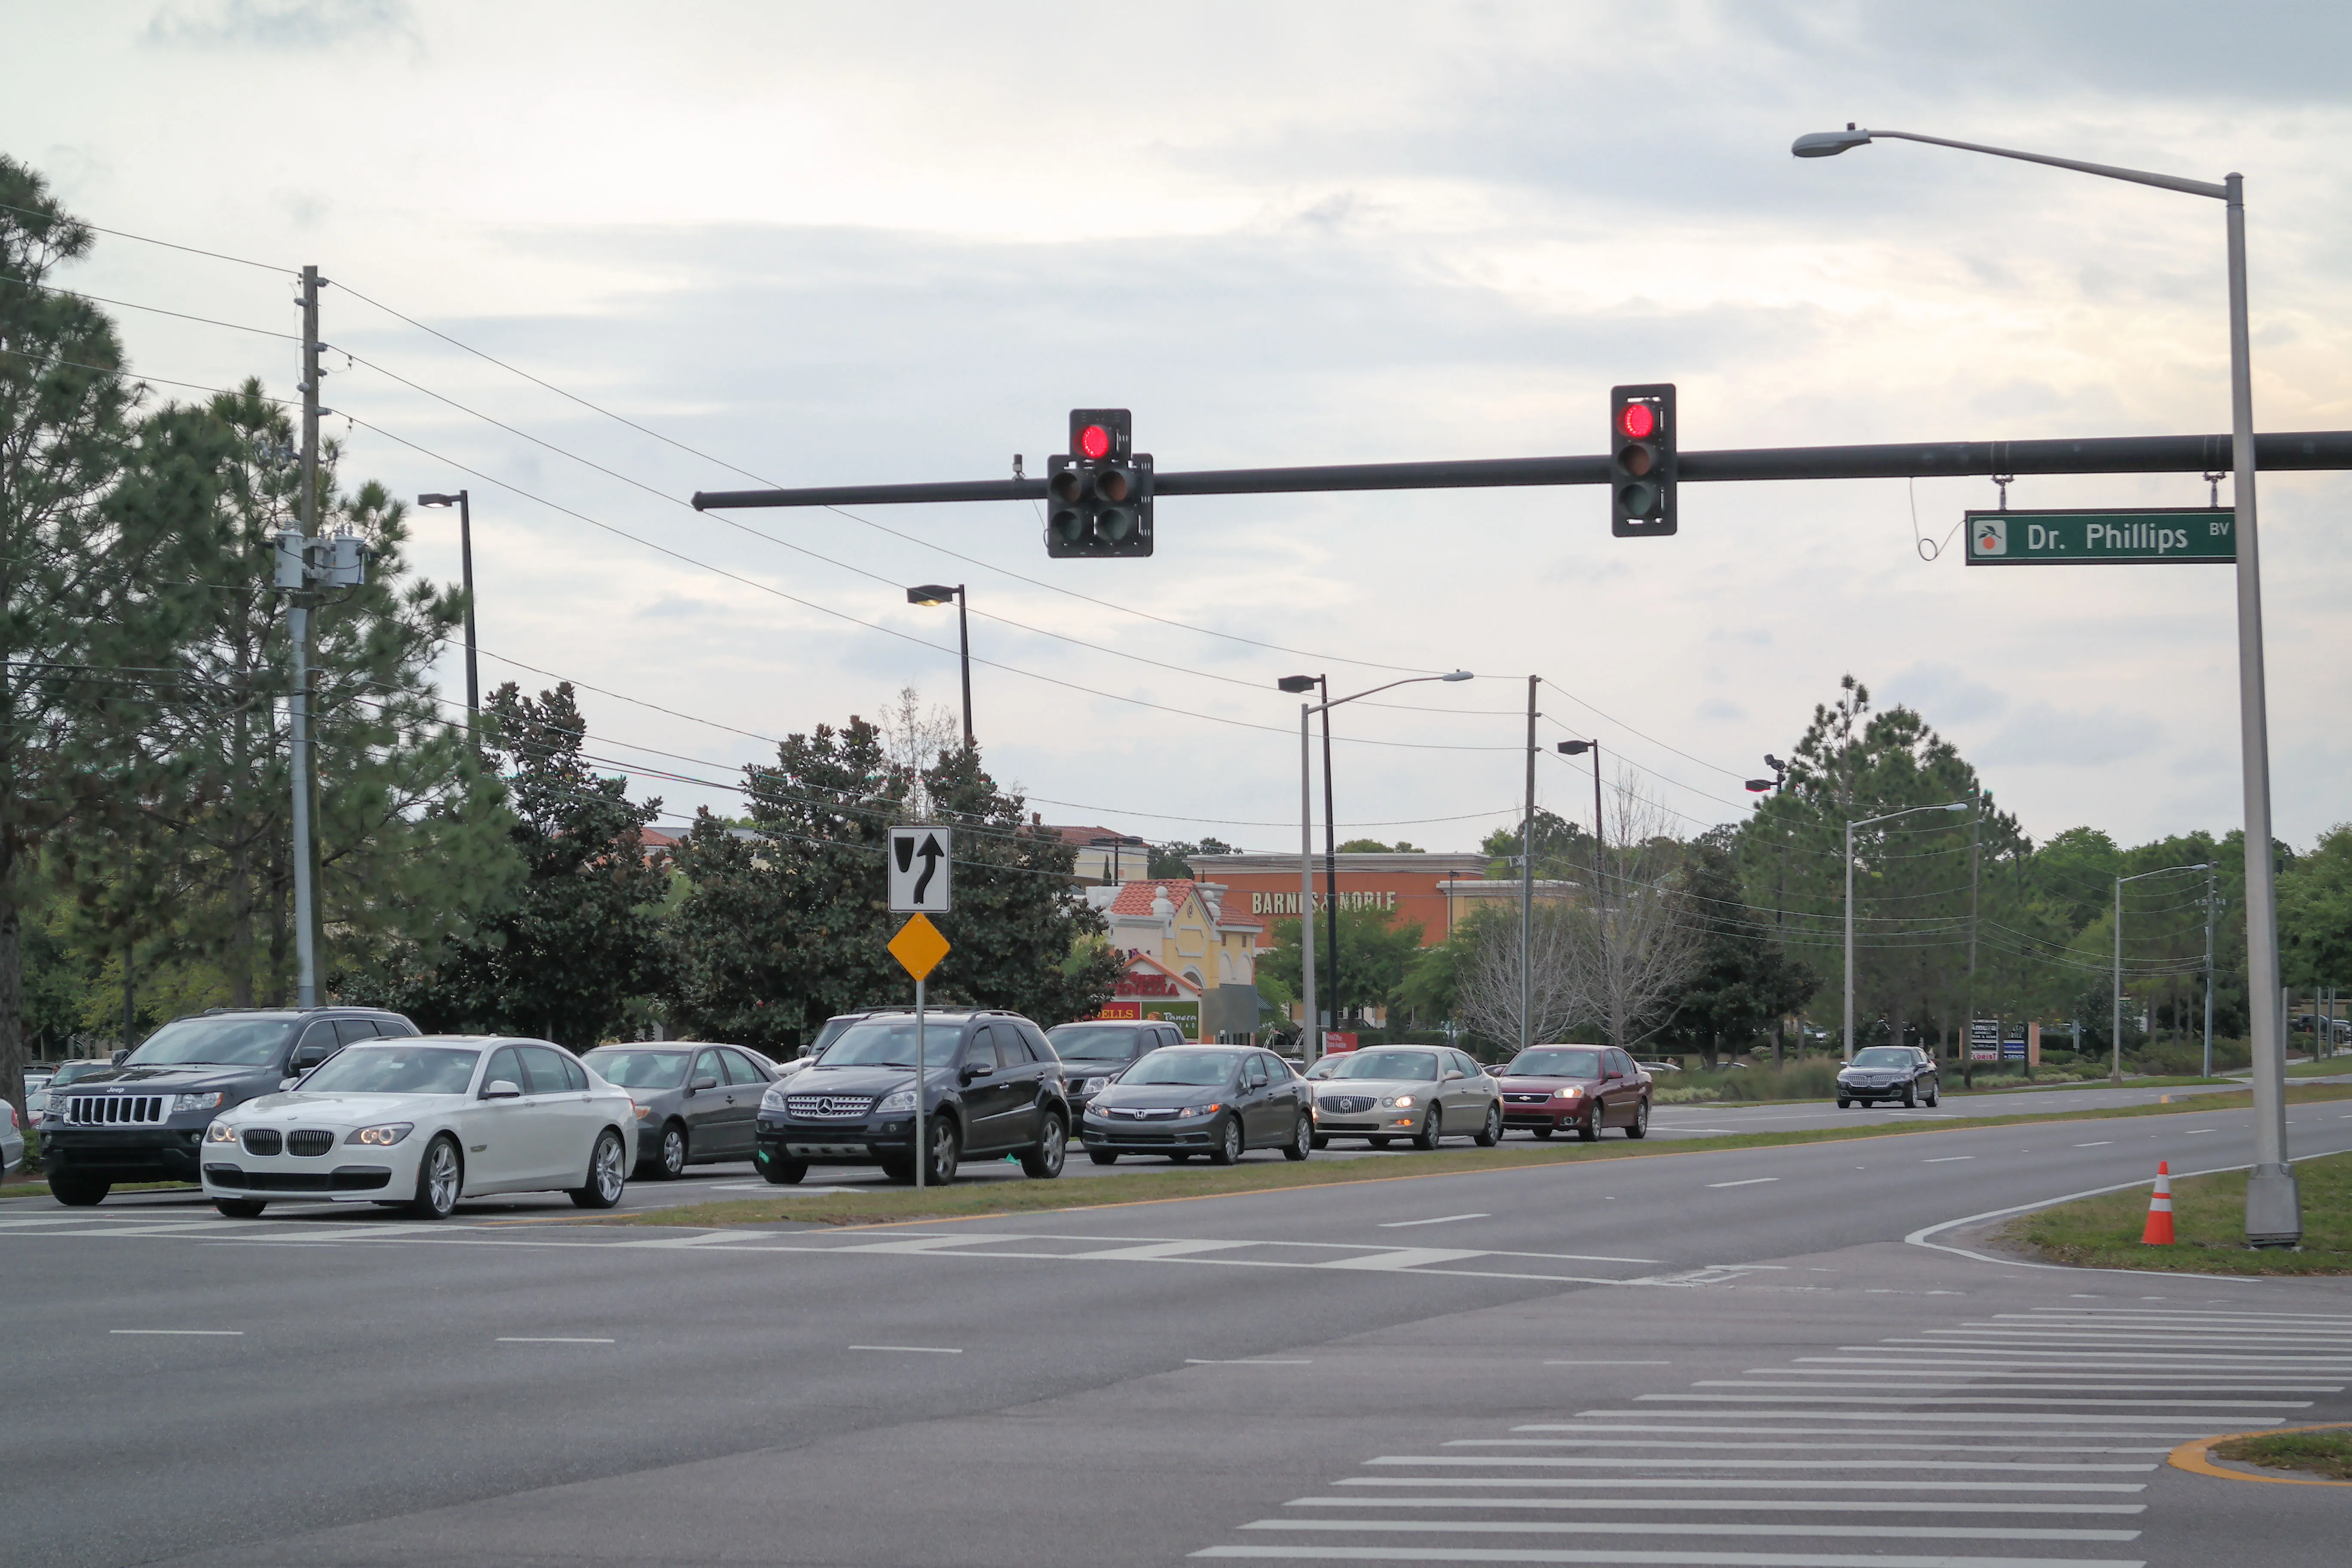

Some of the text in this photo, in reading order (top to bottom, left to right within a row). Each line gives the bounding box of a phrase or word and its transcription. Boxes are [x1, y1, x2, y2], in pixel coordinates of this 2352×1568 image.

[2027, 522, 2230, 554] Dr. Phillips BV
[1163, 1012, 1197, 1021] Panera
